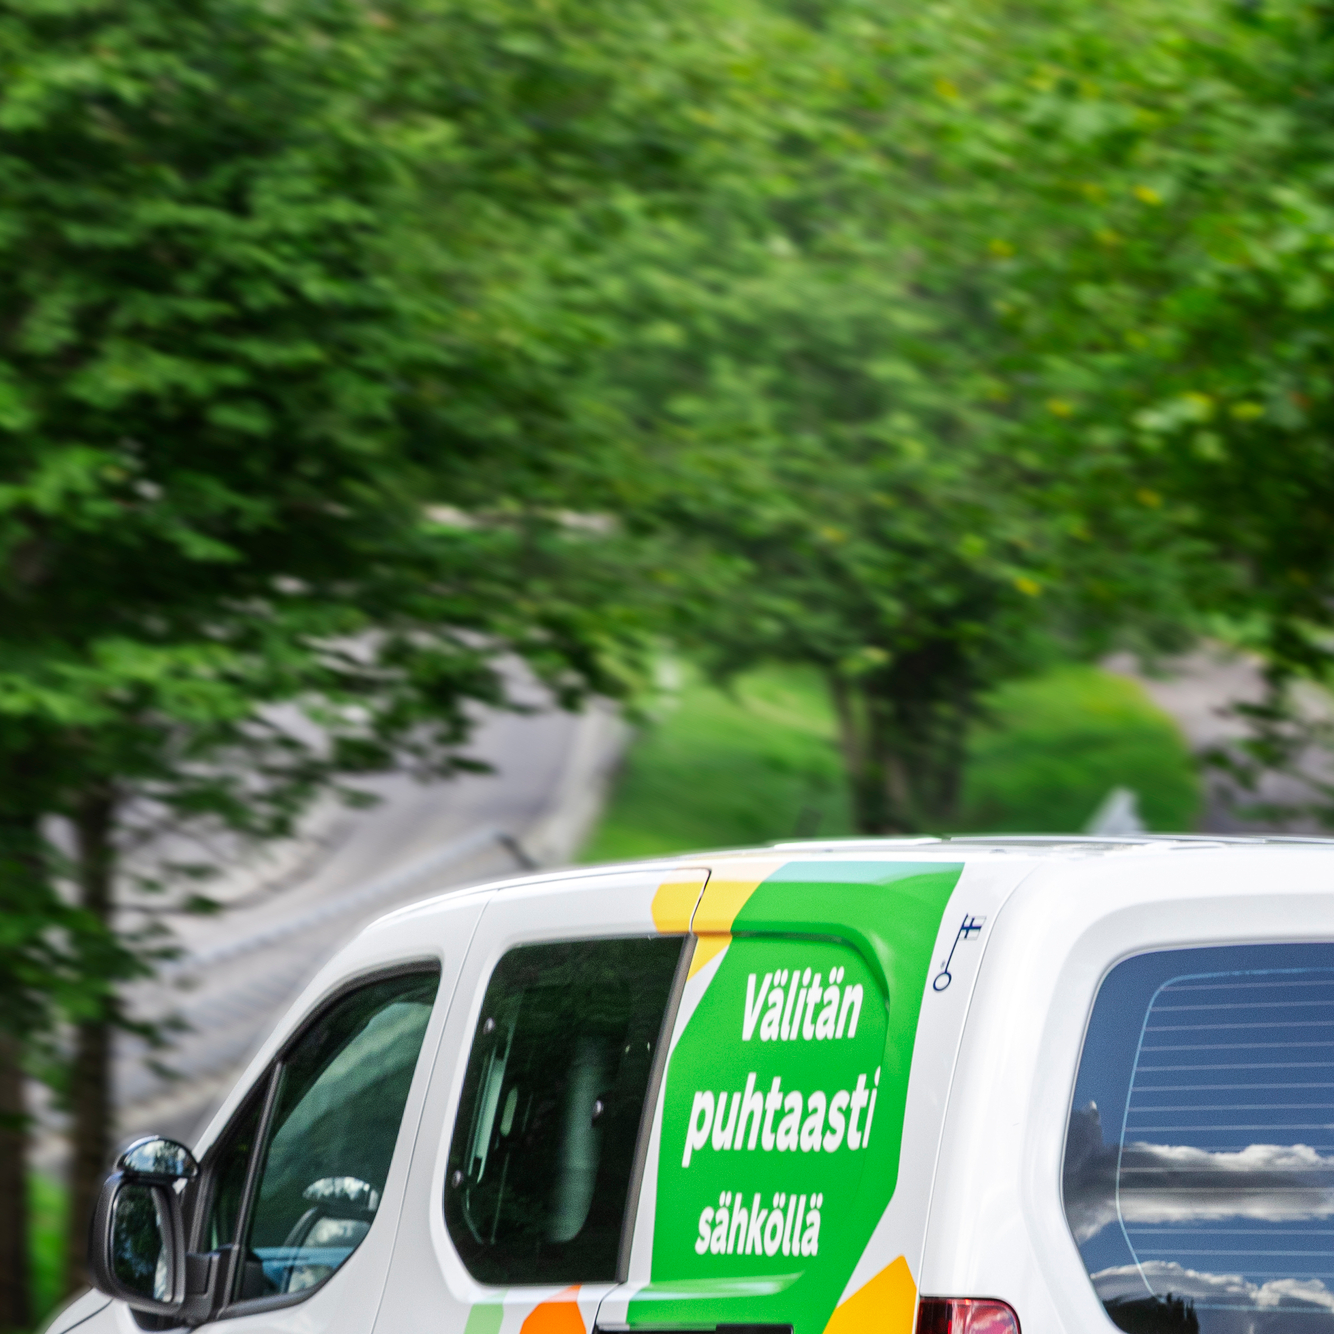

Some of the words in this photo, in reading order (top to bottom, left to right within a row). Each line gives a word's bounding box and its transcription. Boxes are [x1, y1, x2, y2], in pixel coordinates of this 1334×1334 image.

[742, 967, 864, 1042] Välitän
[682, 1066, 881, 1168] puhtaasti
[695, 1191, 823, 1257] sähköllä
